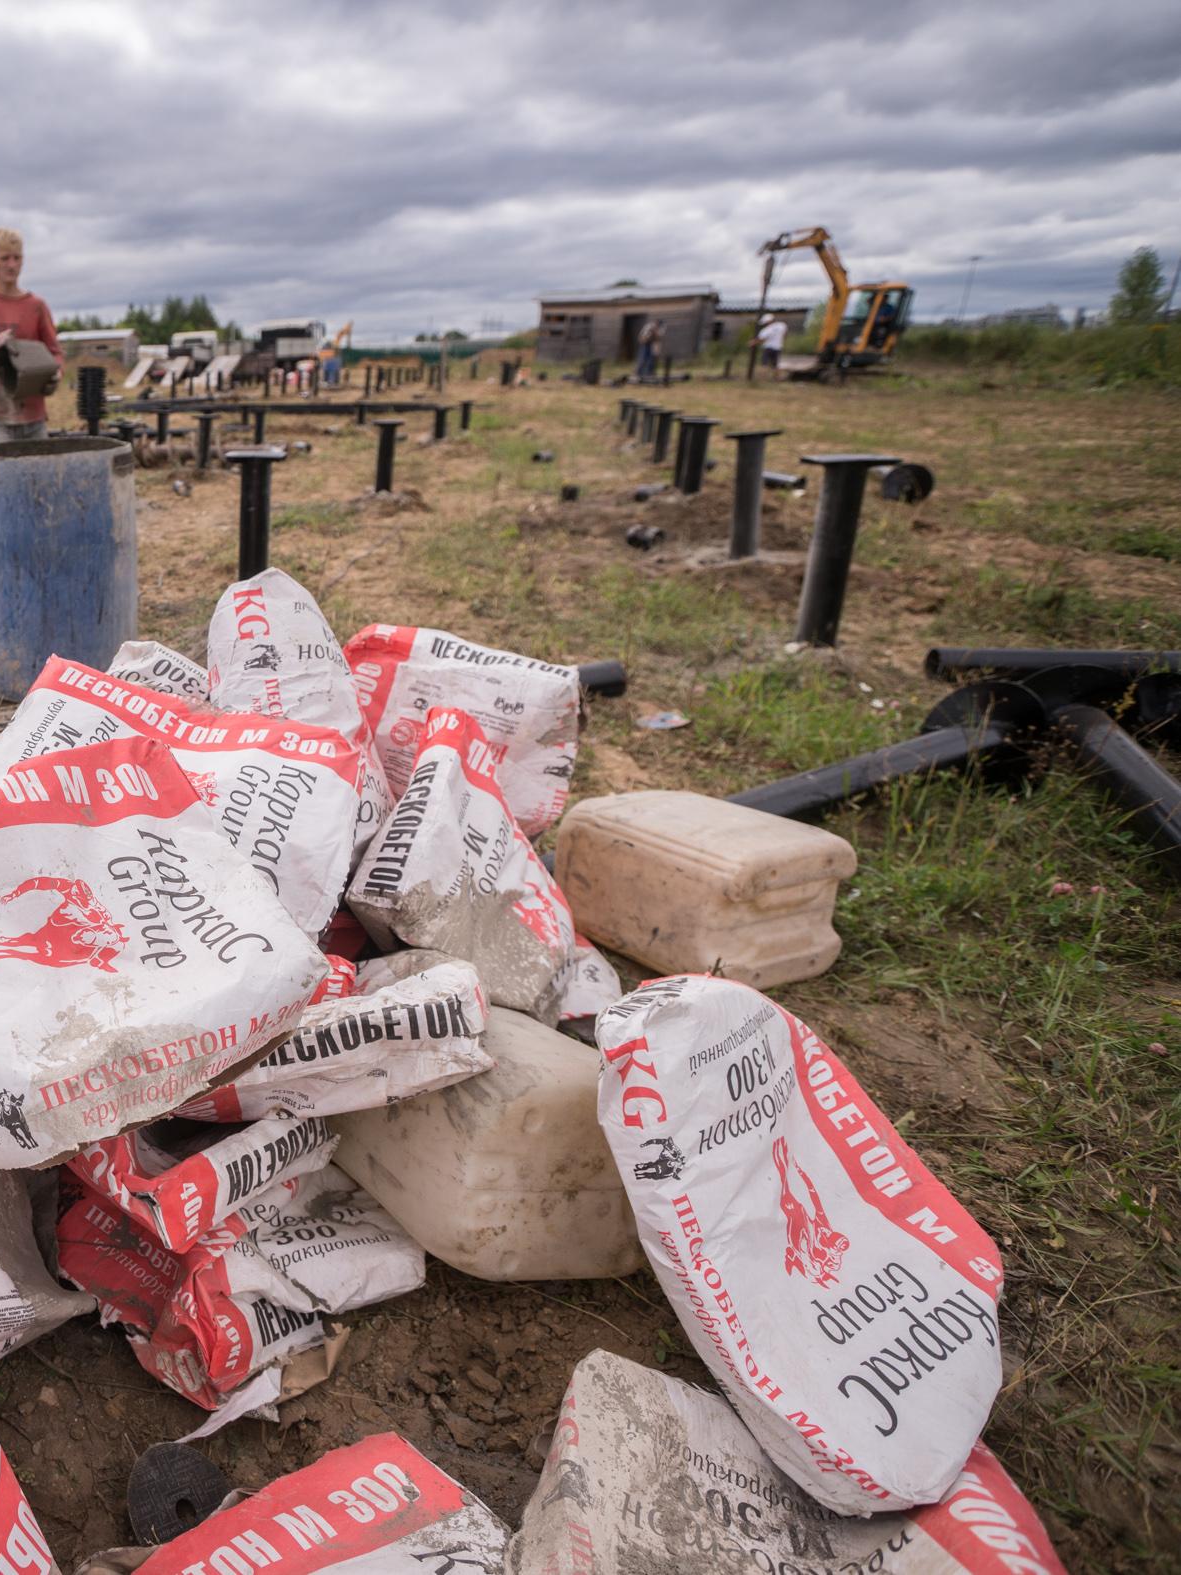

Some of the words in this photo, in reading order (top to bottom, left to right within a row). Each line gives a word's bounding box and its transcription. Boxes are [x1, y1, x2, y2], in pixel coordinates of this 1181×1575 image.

[233, 586, 270, 640] KG
[59, 667, 228, 745] ПЕСКОБЕТОН
[279, 731, 337, 759] 300
[152, 658, 207, 697] -300
[54, 763, 93, 804] М
[96, 760, 160, 803] 300
[362, 760, 440, 901] ПЕСКОБЕТОН
[106, 855, 188, 970] Group
[38, 1024, 238, 1111] ПЕСКОБЕТОН
[603, 1034, 667, 1130] KG
[795, 1017, 913, 1198] КОБЕТОН
[906, 1206, 958, 1245] М
[672, 1193, 785, 1403] ПЕСКОБЕТОН
[811, 1262, 928, 1345] Group
